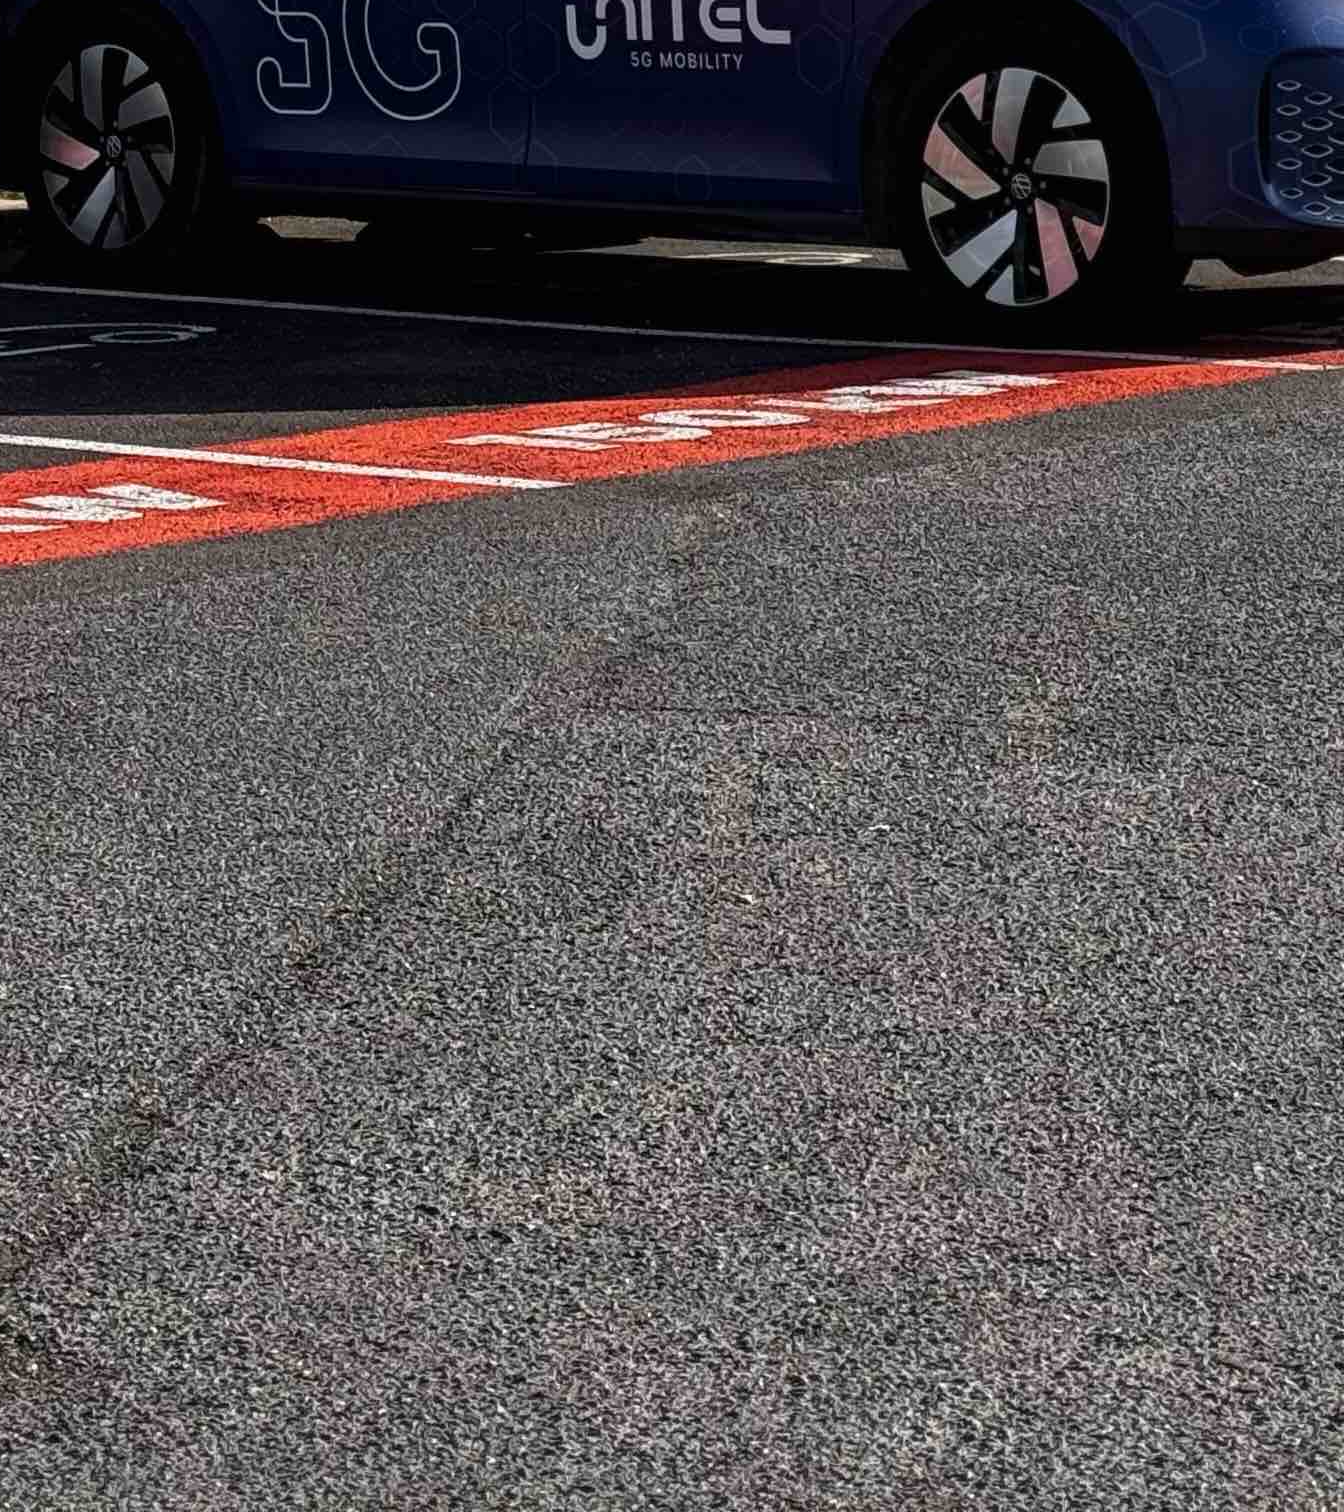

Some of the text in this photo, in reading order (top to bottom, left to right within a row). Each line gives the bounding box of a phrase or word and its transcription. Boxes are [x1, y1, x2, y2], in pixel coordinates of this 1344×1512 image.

[629, 50, 744, 71] 5G MOBILITY
[441, 369, 1065, 452] 150 kW
